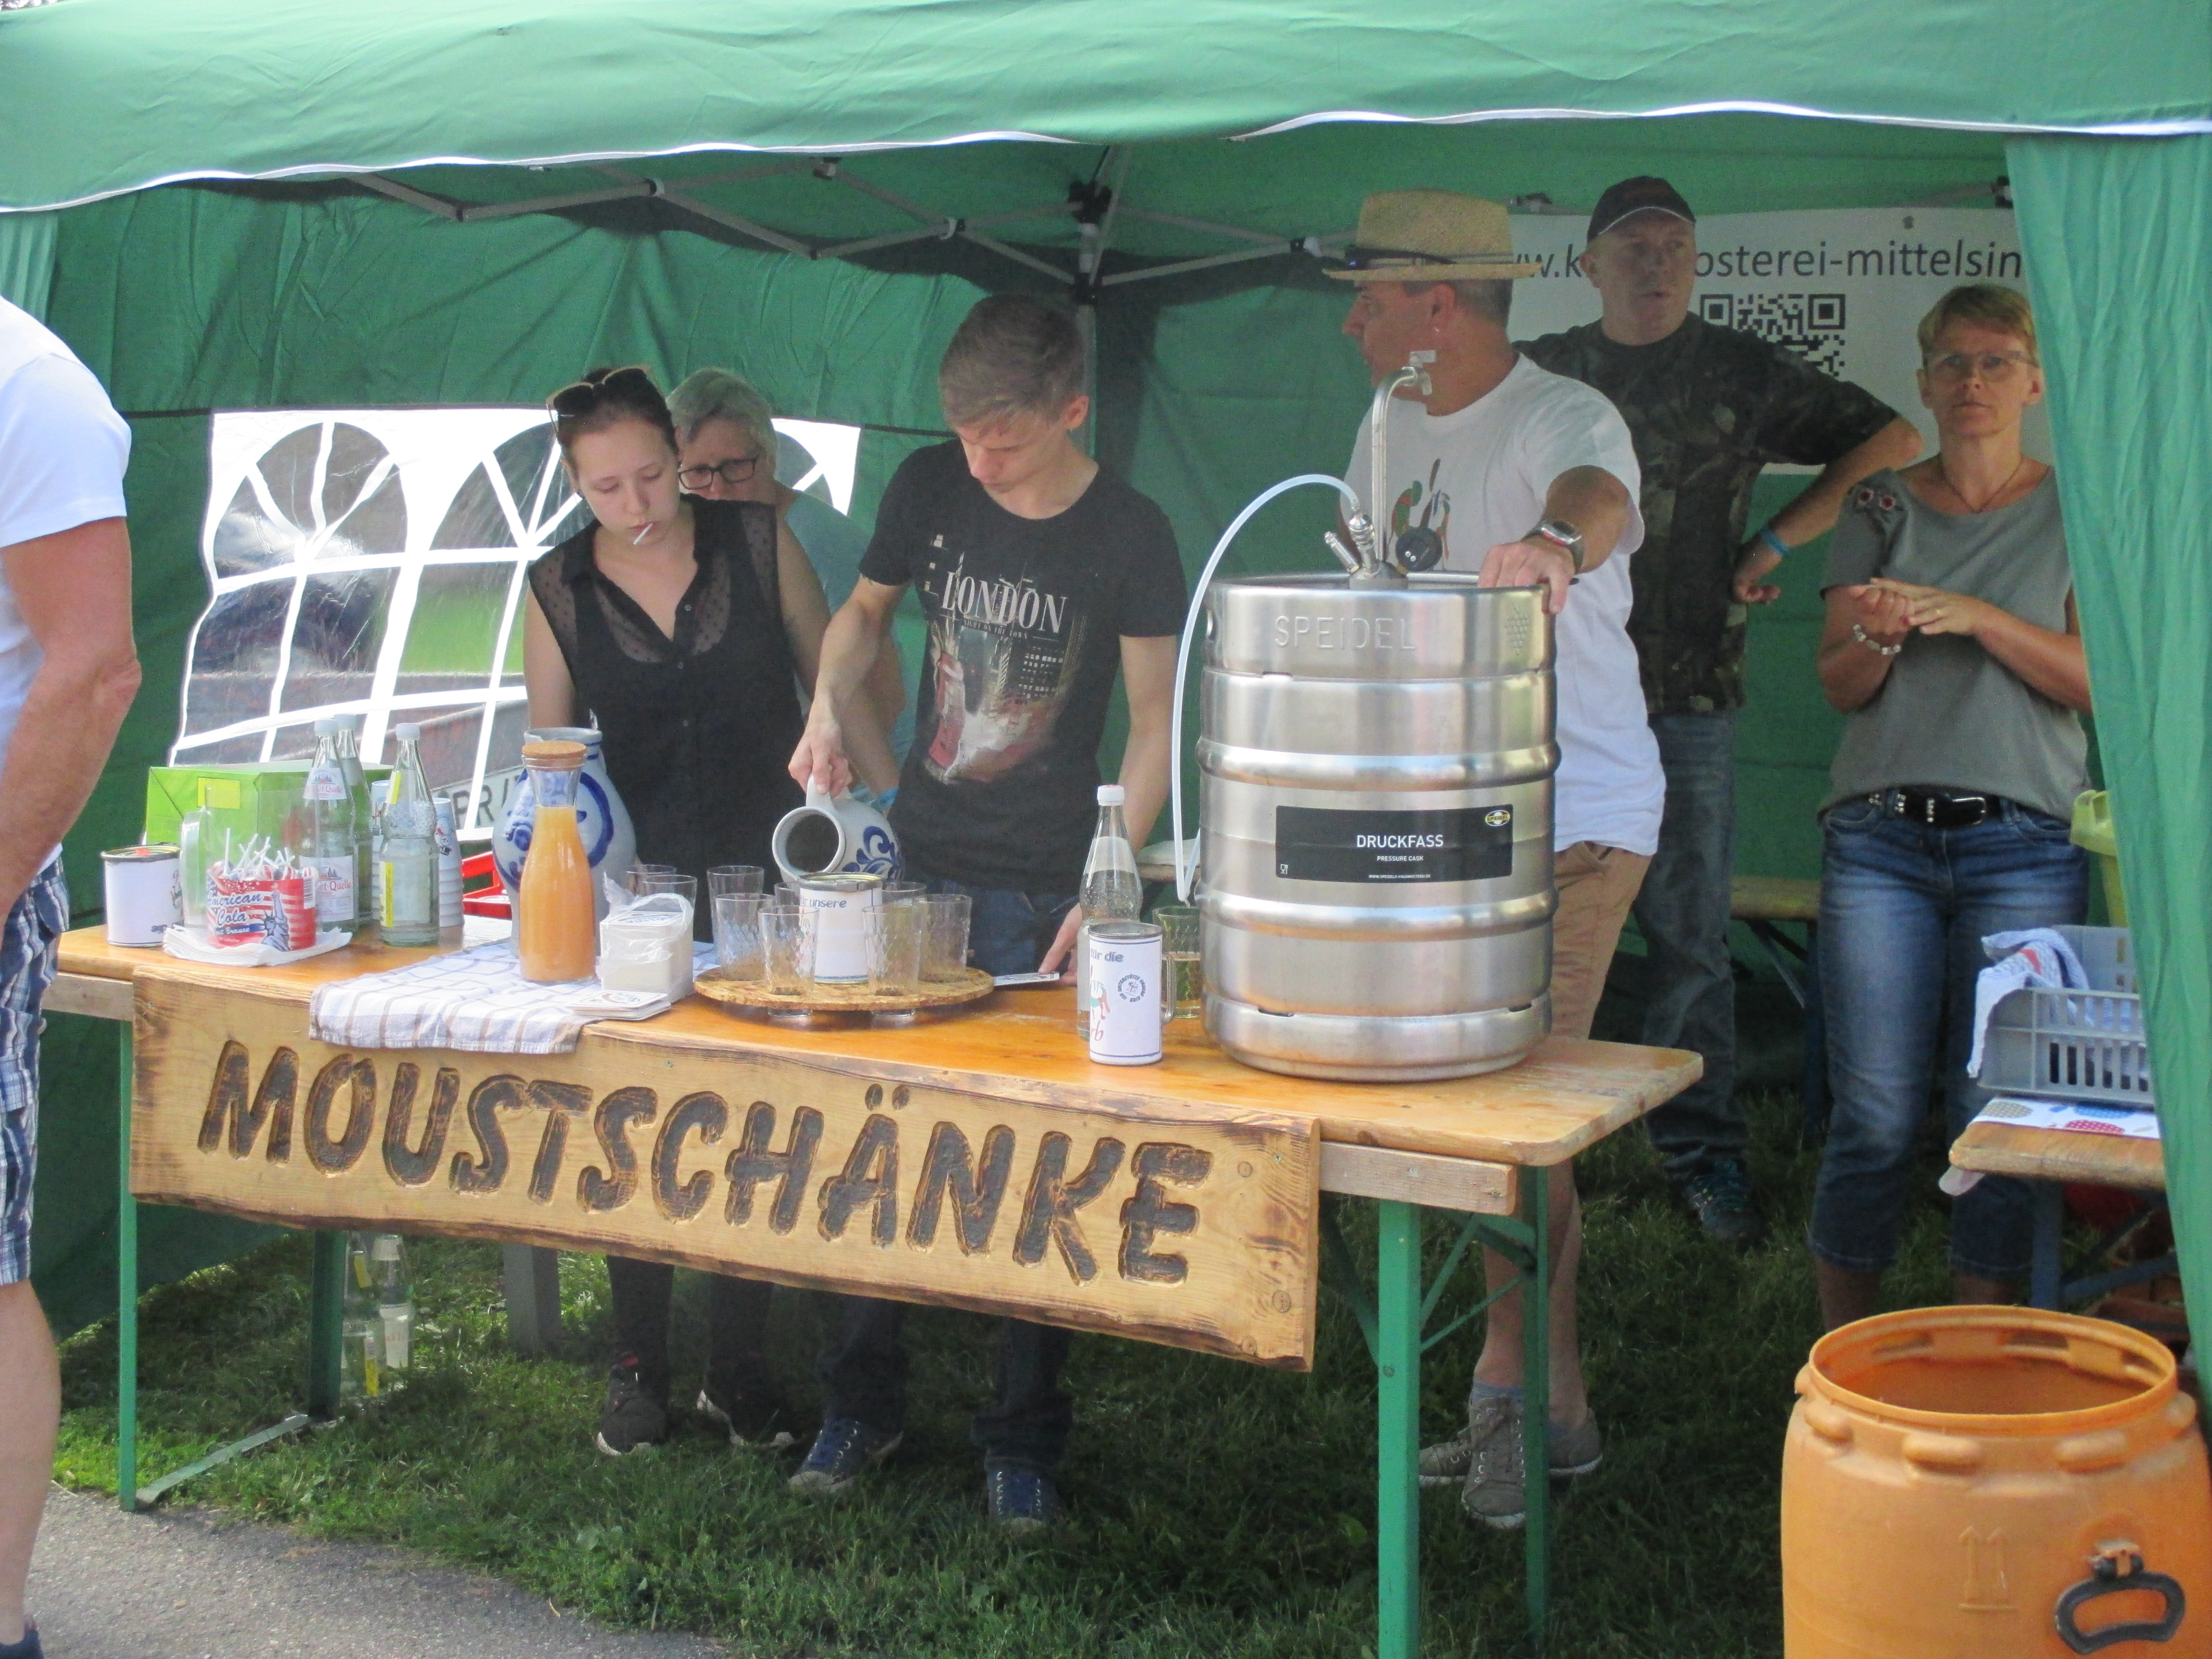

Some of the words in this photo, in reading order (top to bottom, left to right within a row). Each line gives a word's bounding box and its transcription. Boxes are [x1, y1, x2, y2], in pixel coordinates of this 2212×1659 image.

[1275, 615, 1417, 650] SPEIDEL
[1357, 834, 1444, 848] DRUCKFASS
[809, 899, 847, 908] unsere
[217, 909, 247, 926] Cola
[1104, 951, 1124, 963] die
[197, 1039, 1214, 1287] MOUSTSCHÄNKE
